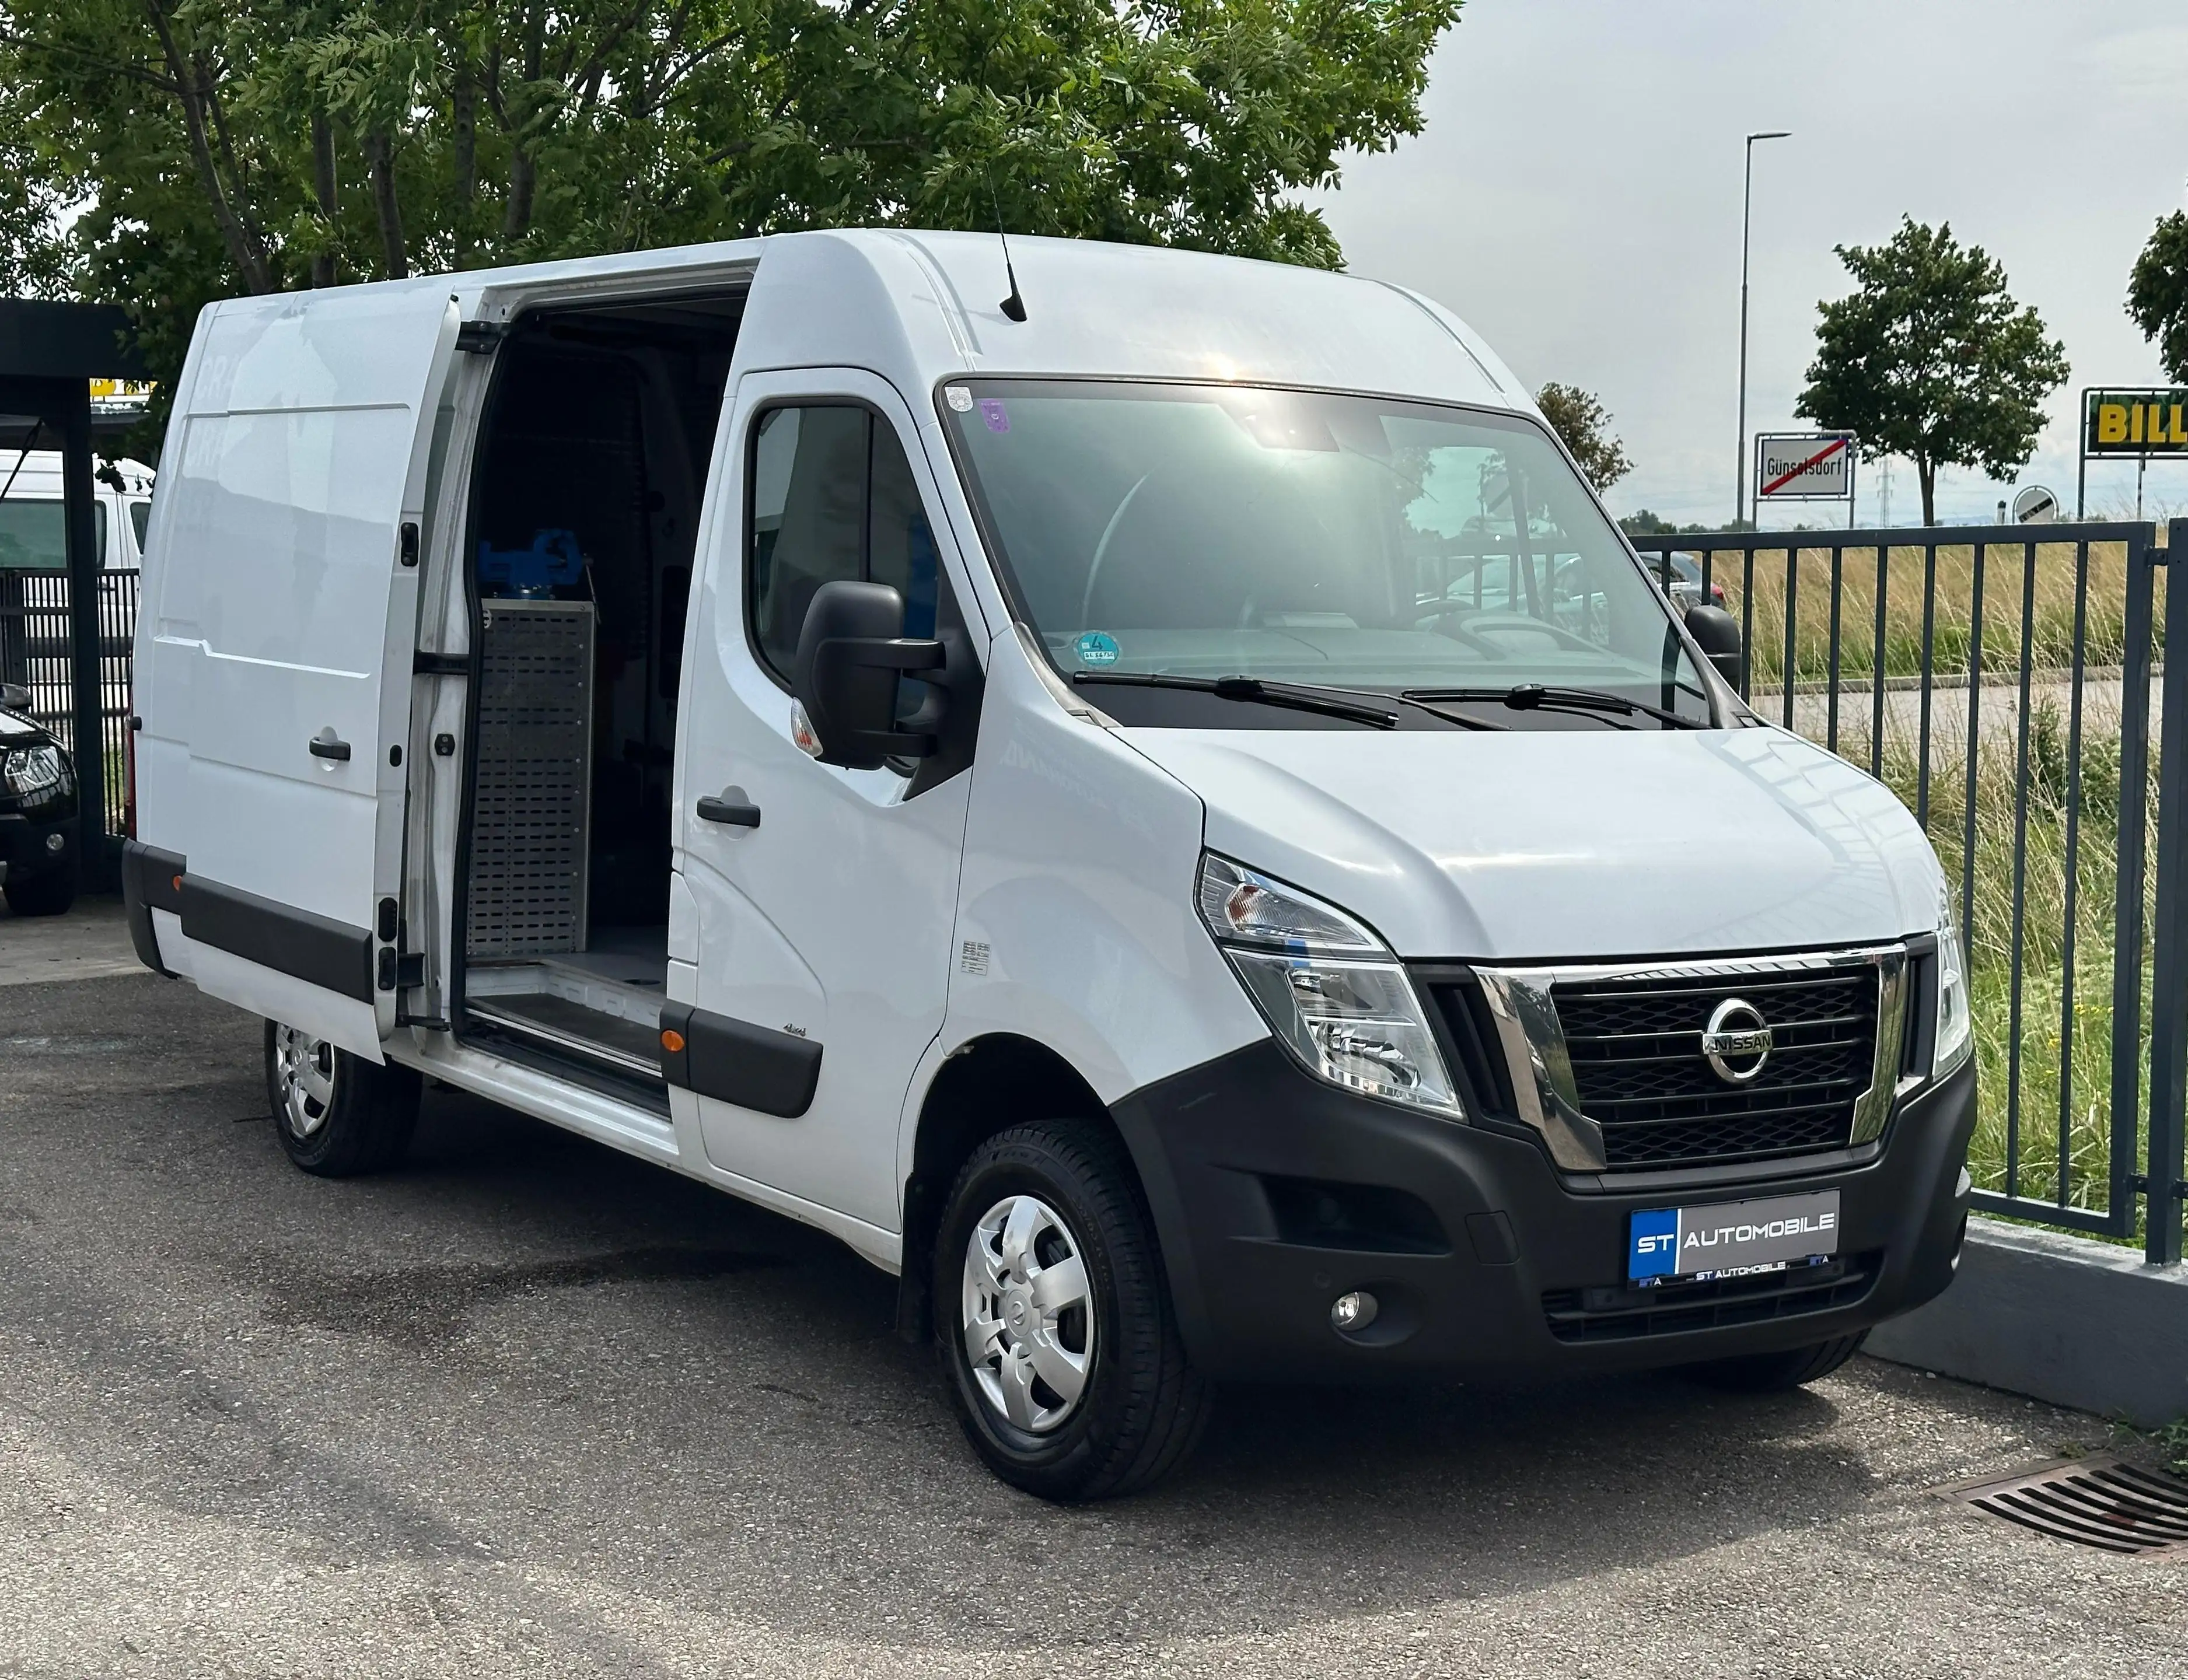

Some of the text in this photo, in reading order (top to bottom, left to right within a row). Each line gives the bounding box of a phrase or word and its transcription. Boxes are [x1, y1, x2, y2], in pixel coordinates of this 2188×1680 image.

[1714, 1035, 1771, 1051] NISSAN
[1637, 1212, 1834, 1254] ST AUTOMOBILE
[1696, 1261, 1786, 1281] ST AUTOMOBILE
